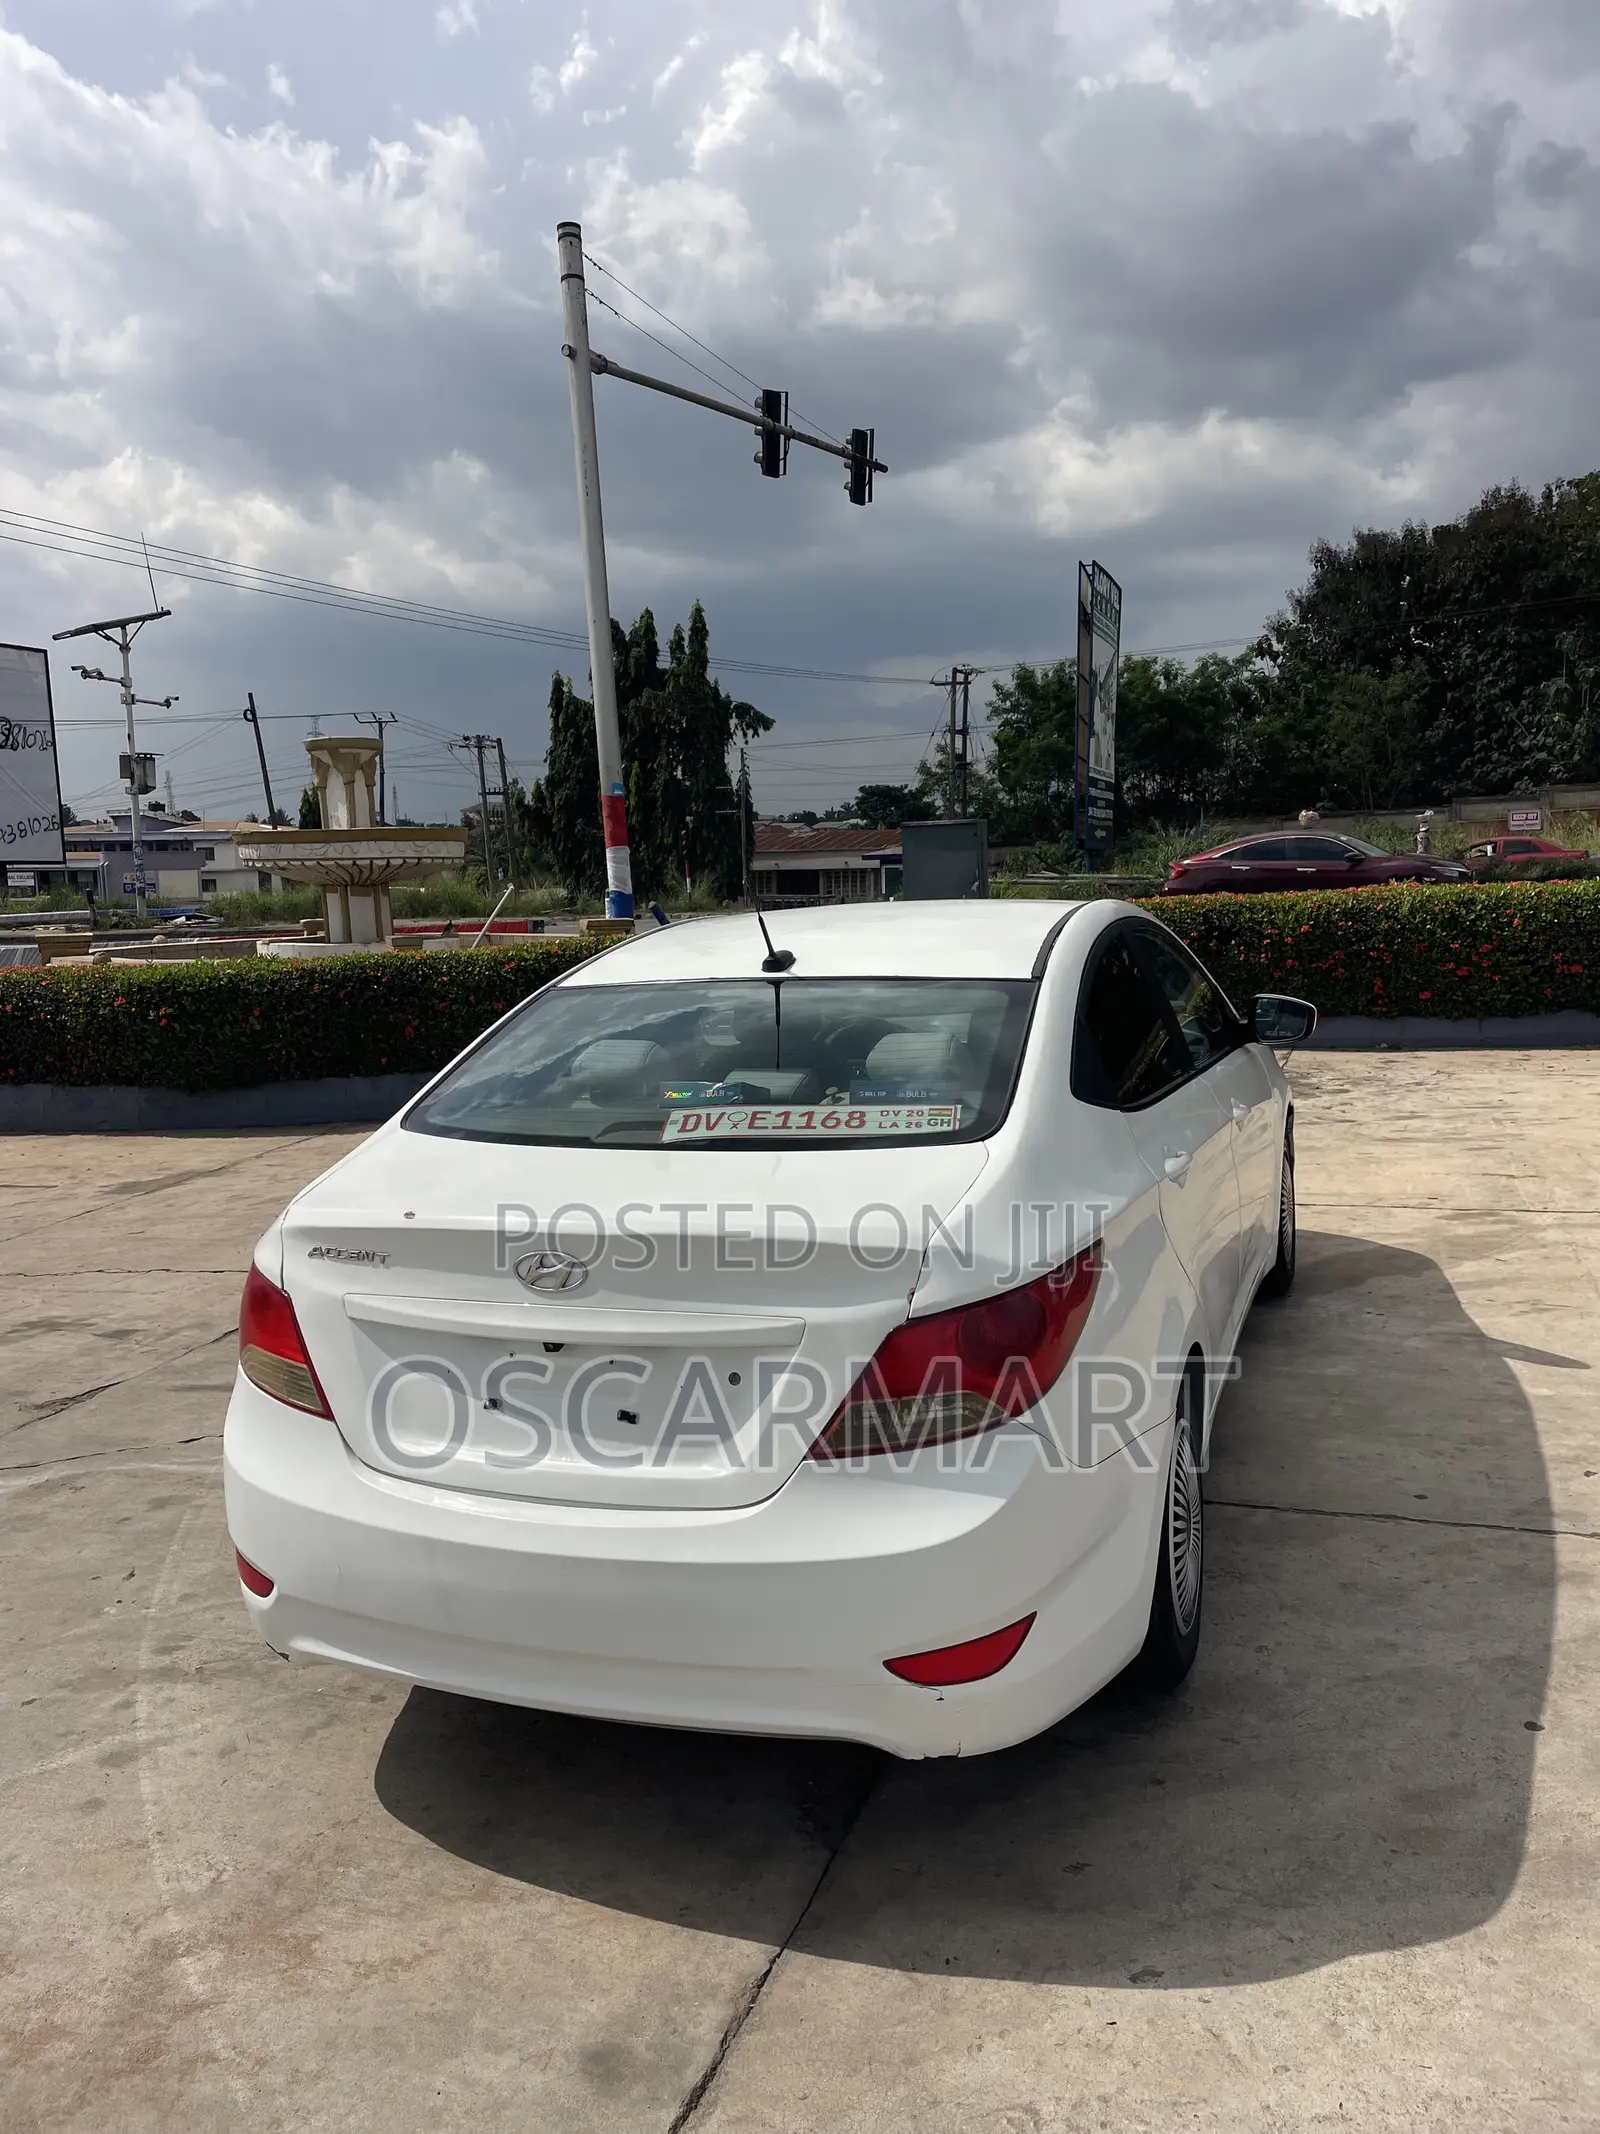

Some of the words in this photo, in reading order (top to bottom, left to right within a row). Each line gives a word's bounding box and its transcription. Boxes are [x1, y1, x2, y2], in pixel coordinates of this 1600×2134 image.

[905, 1090, 927, 1098] BULB
[906, 1109, 924, 1117] 20
[676, 1111, 726, 1133] DV
[747, 1110, 867, 1130] E1168
[878, 1121, 899, 1129] LA
[926, 1117, 951, 1128] GH
[306, 1244, 392, 1265] ACCENT
